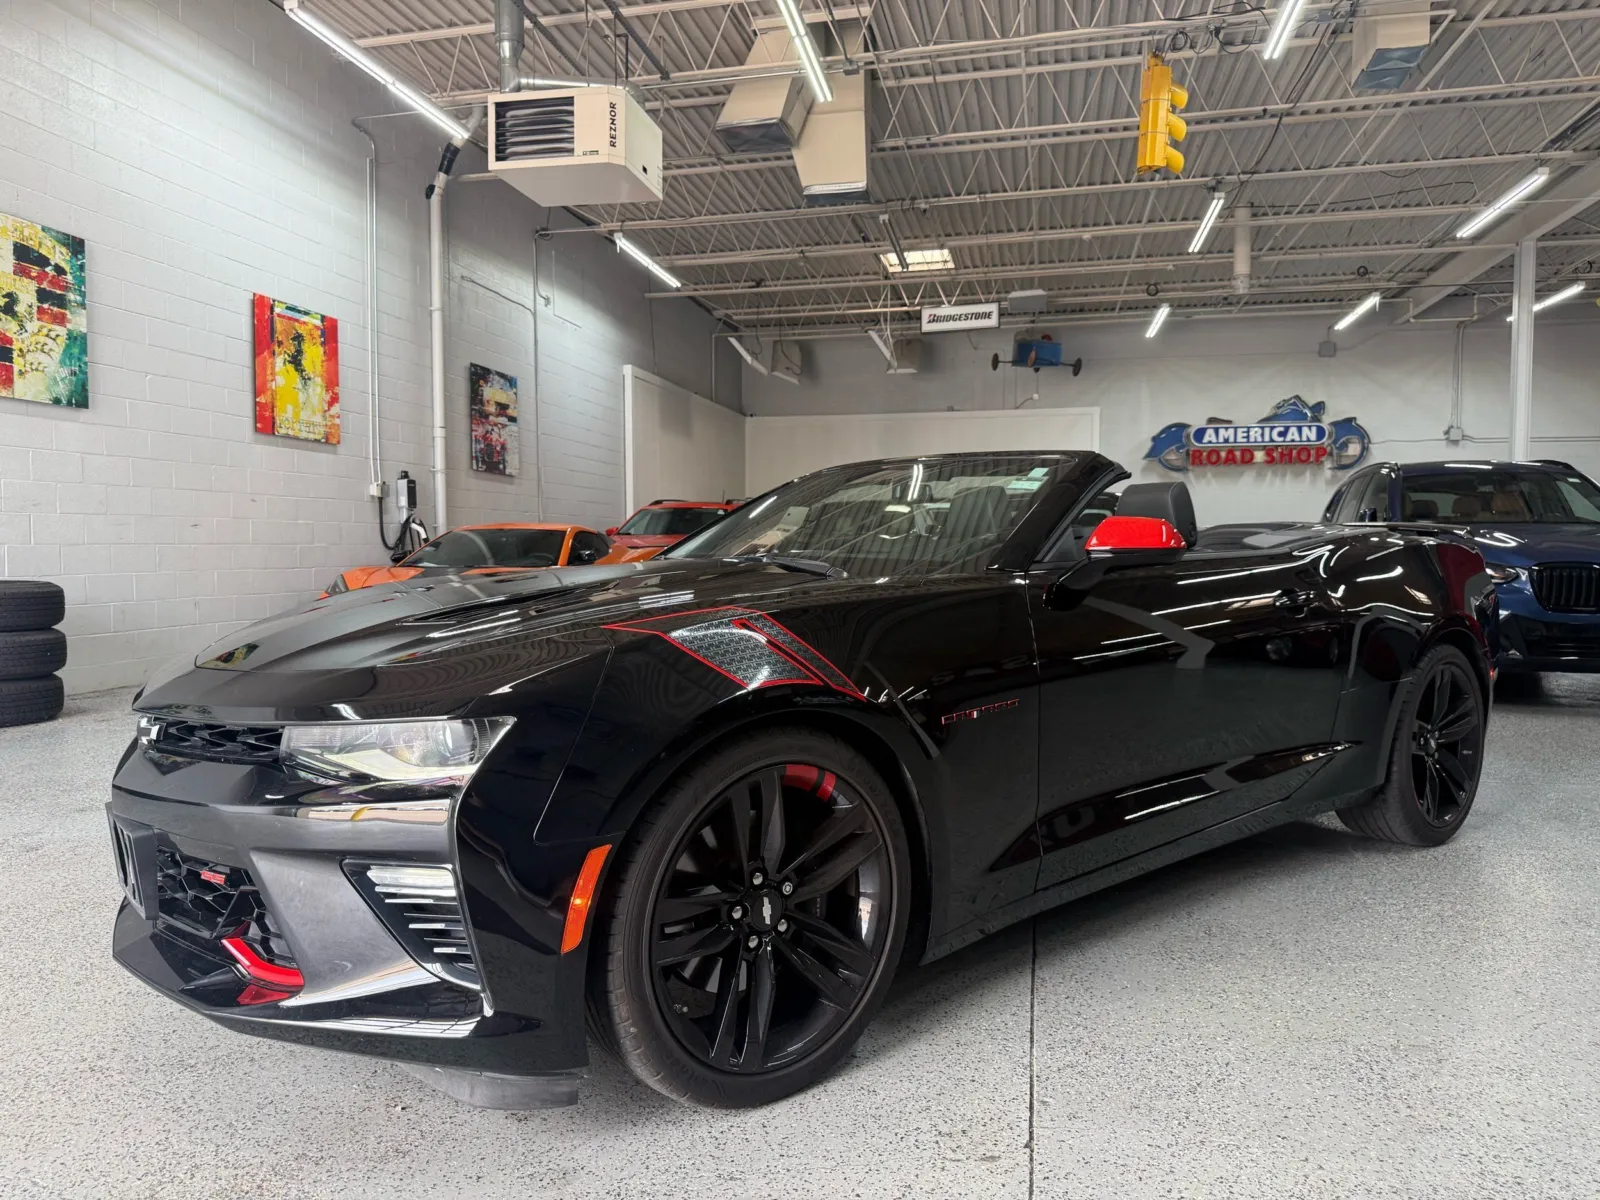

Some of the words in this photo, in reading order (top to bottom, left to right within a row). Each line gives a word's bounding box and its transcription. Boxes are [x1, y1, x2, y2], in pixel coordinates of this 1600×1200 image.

[609, 102, 617, 148] REZNOR
[926, 311, 994, 324] BRIDGESTONE
[1202, 426, 1317, 443] AMERICAN
[1190, 447, 1255, 466] ROAD
[1263, 446, 1328, 465] SHOP
